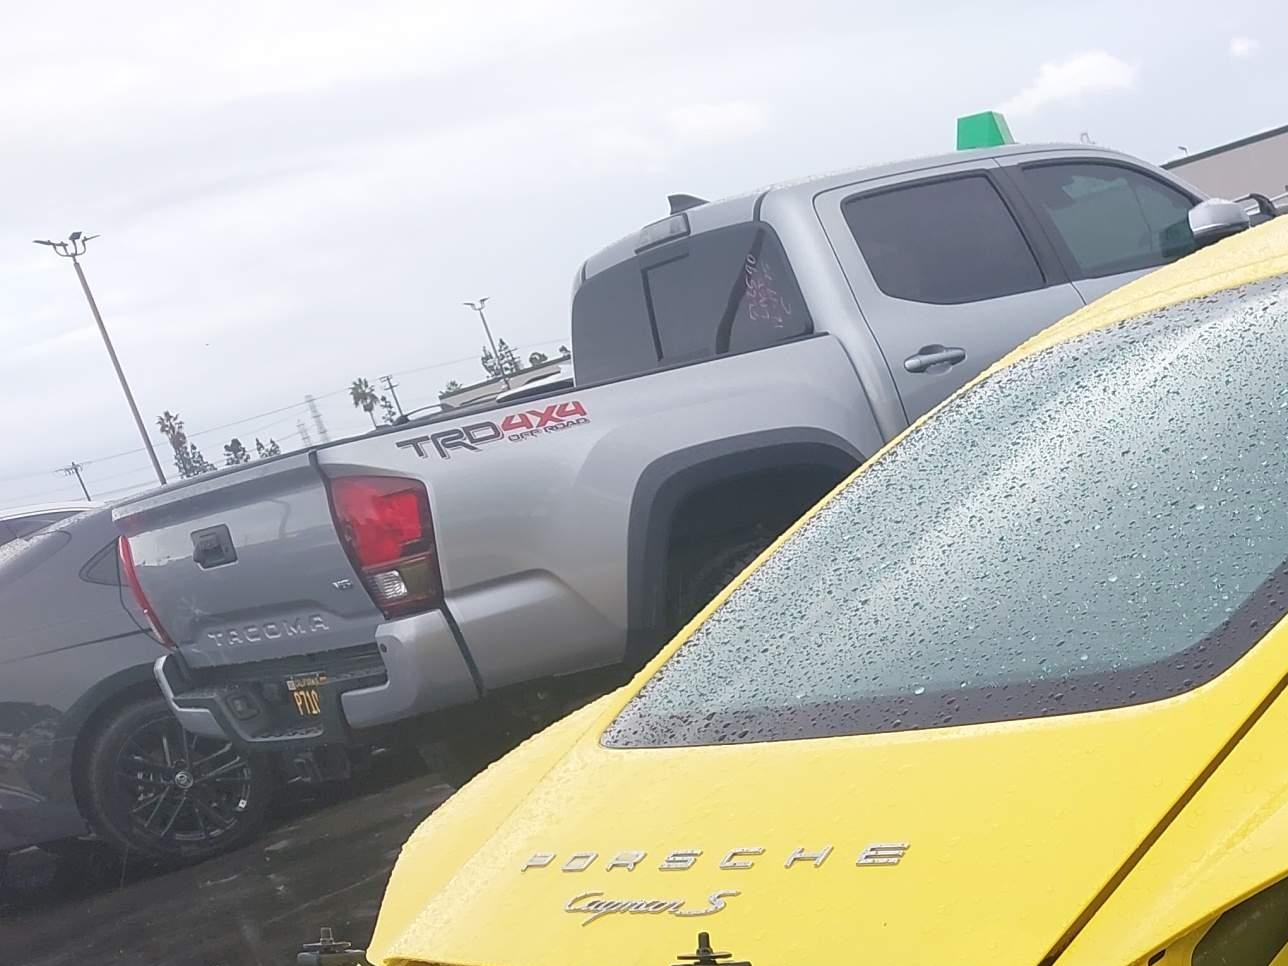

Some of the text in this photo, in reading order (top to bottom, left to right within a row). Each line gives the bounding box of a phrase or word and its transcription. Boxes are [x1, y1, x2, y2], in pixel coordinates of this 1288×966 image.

[396, 421, 504, 460] TRD
[508, 417, 590, 442] OFF ROAD
[208, 615, 330, 647] TACOMA
[521, 841, 910, 872] PORSCHE
[564, 890, 742, 926] Cayman S
